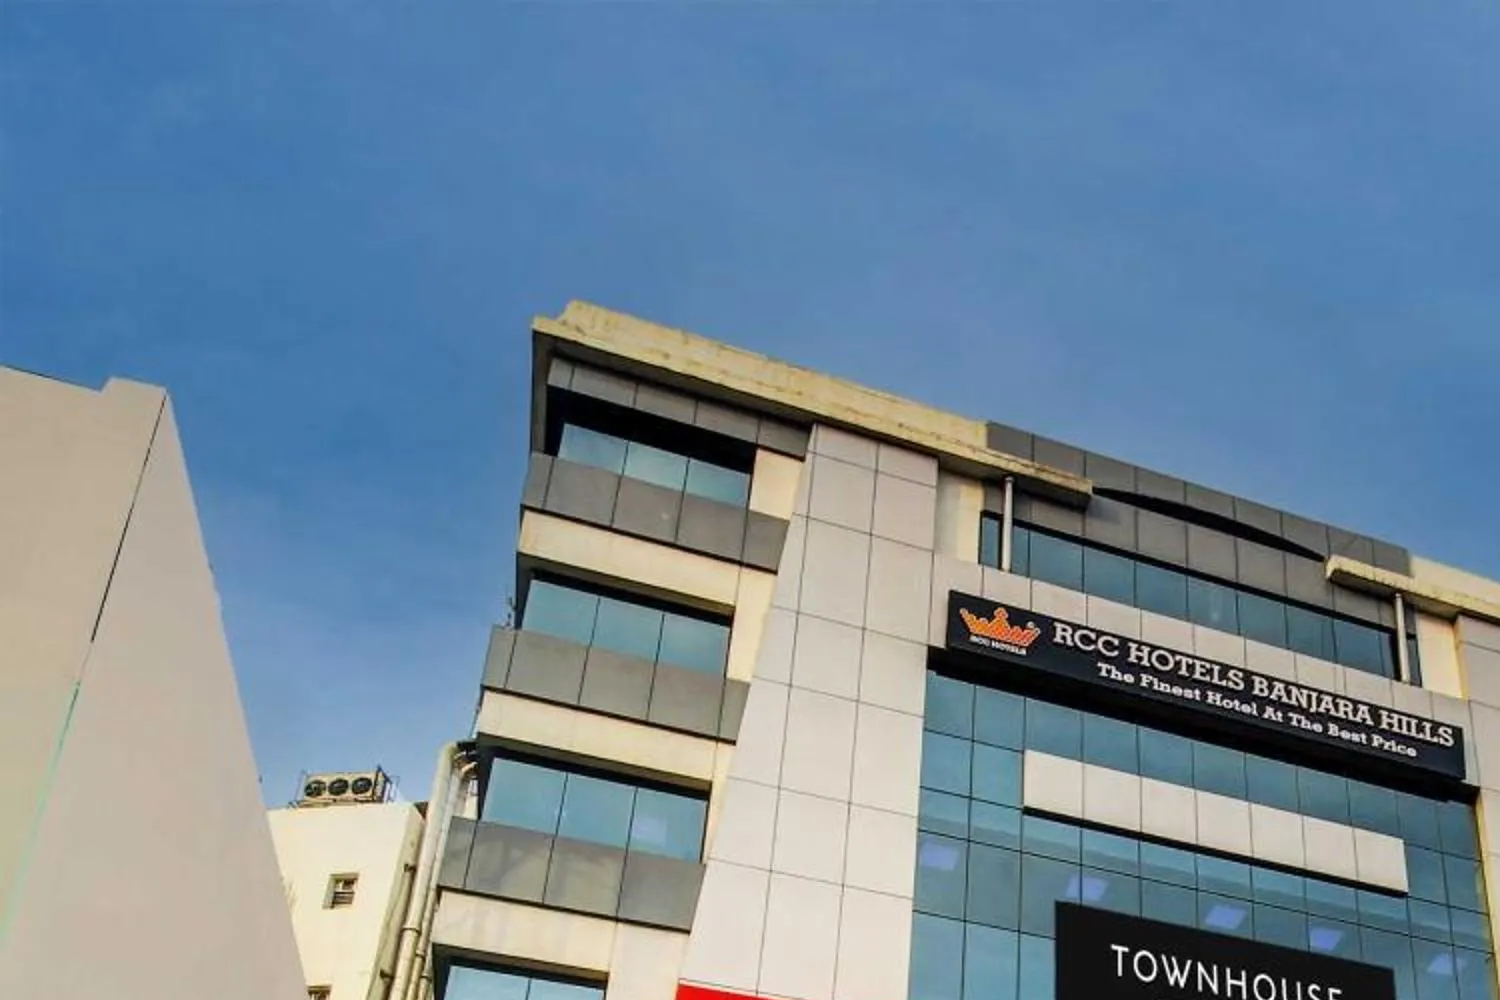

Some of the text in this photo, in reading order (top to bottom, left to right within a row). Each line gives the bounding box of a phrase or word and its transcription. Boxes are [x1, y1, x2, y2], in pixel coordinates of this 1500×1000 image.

[1052, 621, 1455, 747] RCC HOTELS BANJARA HILLS
[1097, 661, 1418, 758] The Finest Hotel At The Best Price
